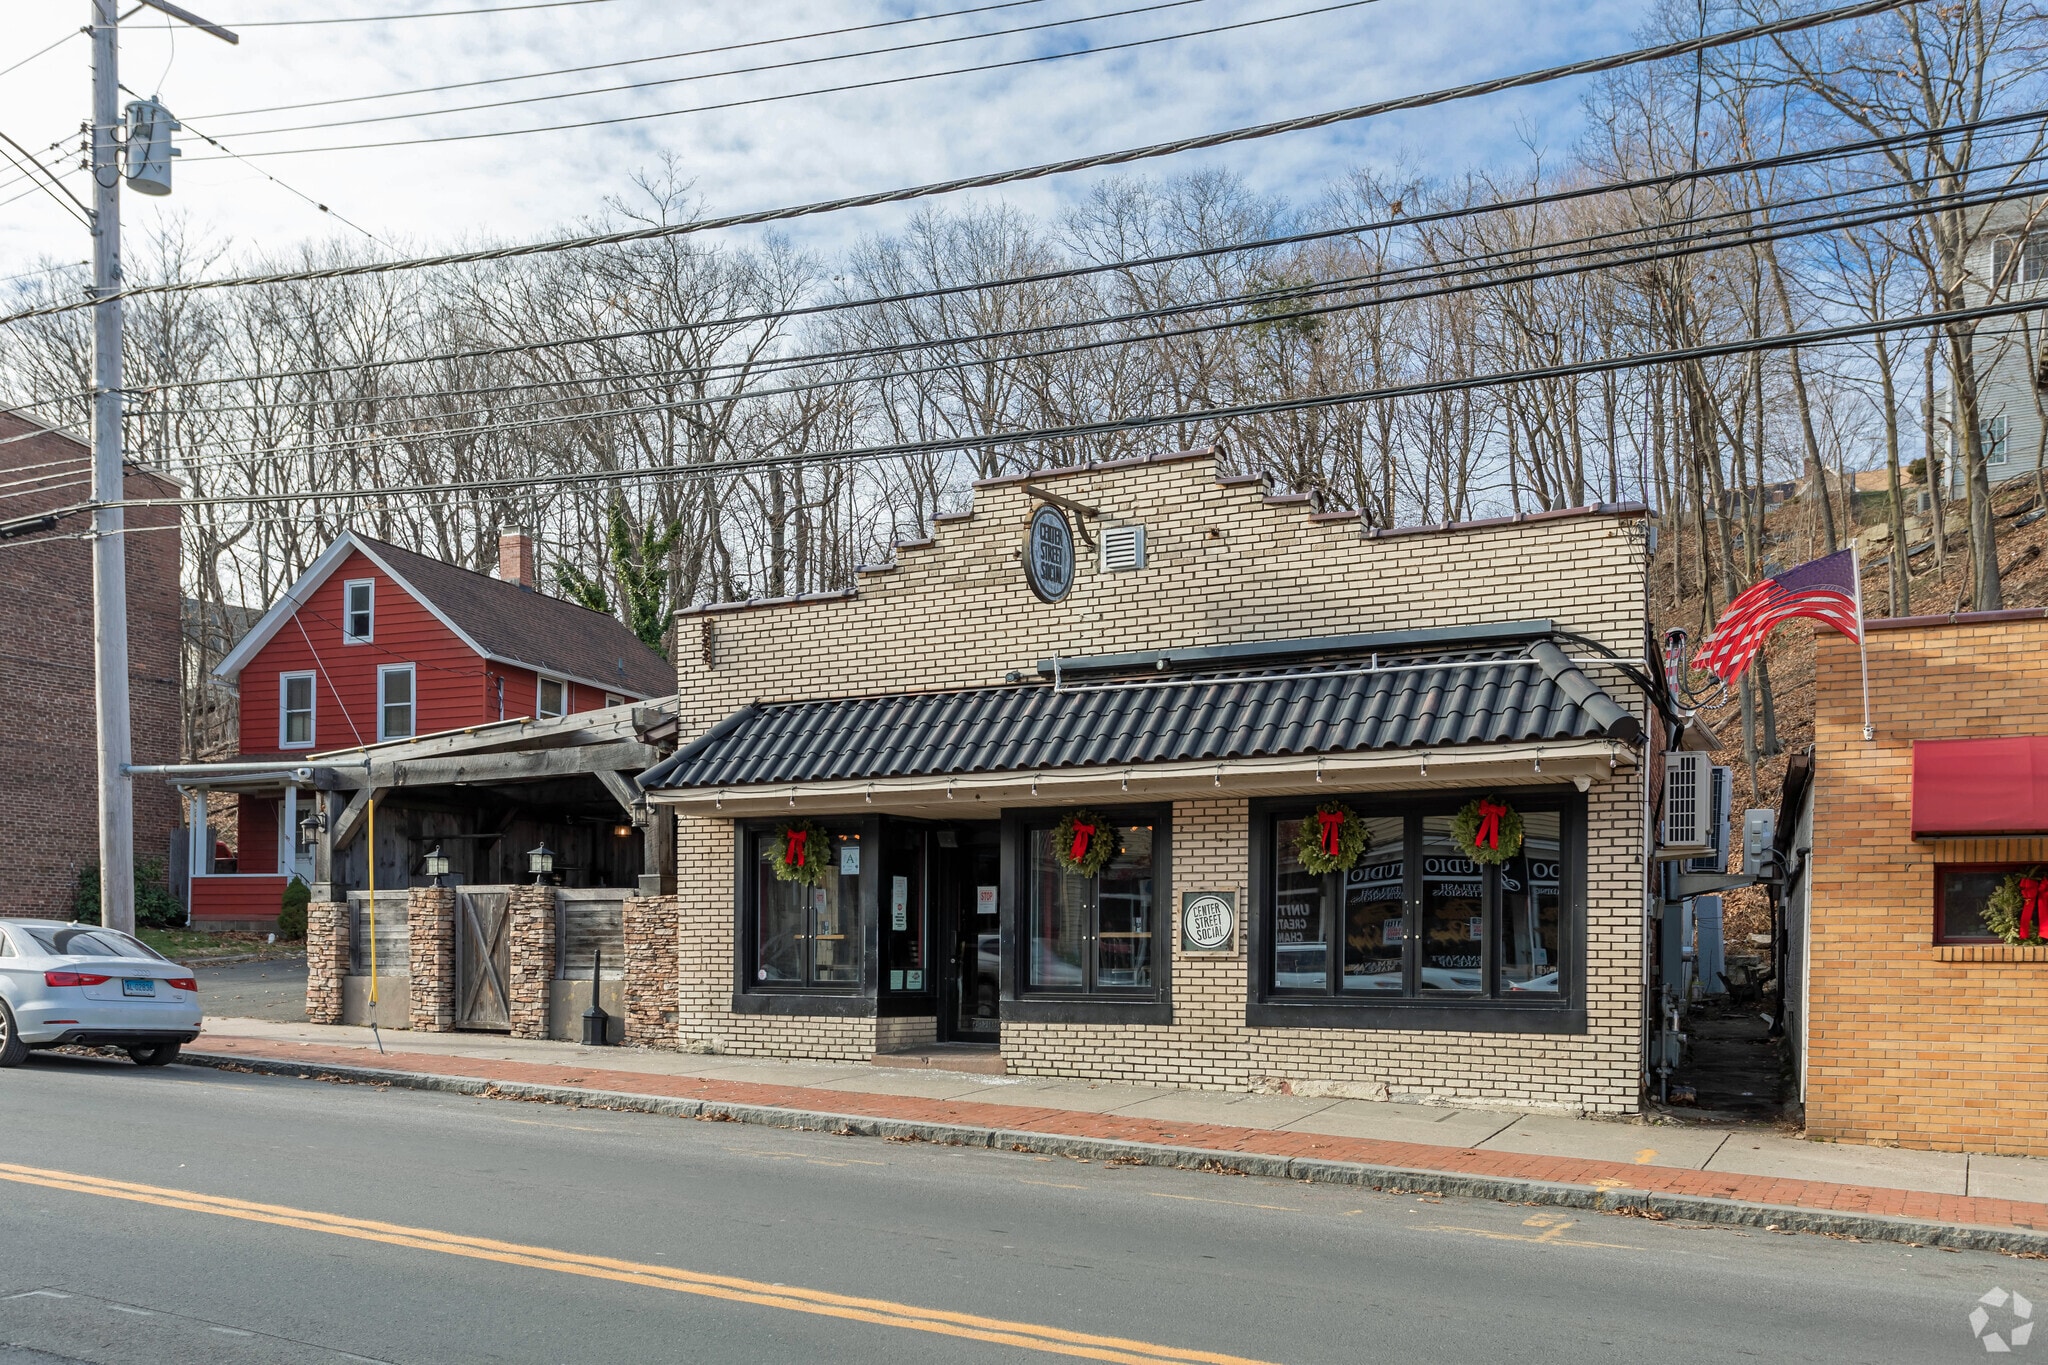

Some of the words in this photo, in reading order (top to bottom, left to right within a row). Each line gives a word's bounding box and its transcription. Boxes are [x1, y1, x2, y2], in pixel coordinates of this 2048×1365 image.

[1040, 523, 1062, 546] CENTER
[1040, 542, 1062, 566] STREET
[1040, 562, 1063, 584] SOCIAL
[846, 853, 855, 863] A
[1193, 903, 1220, 917] CENTER
[1195, 914, 1221, 929] STREET
[1197, 926, 1224, 940] SOCIAL
